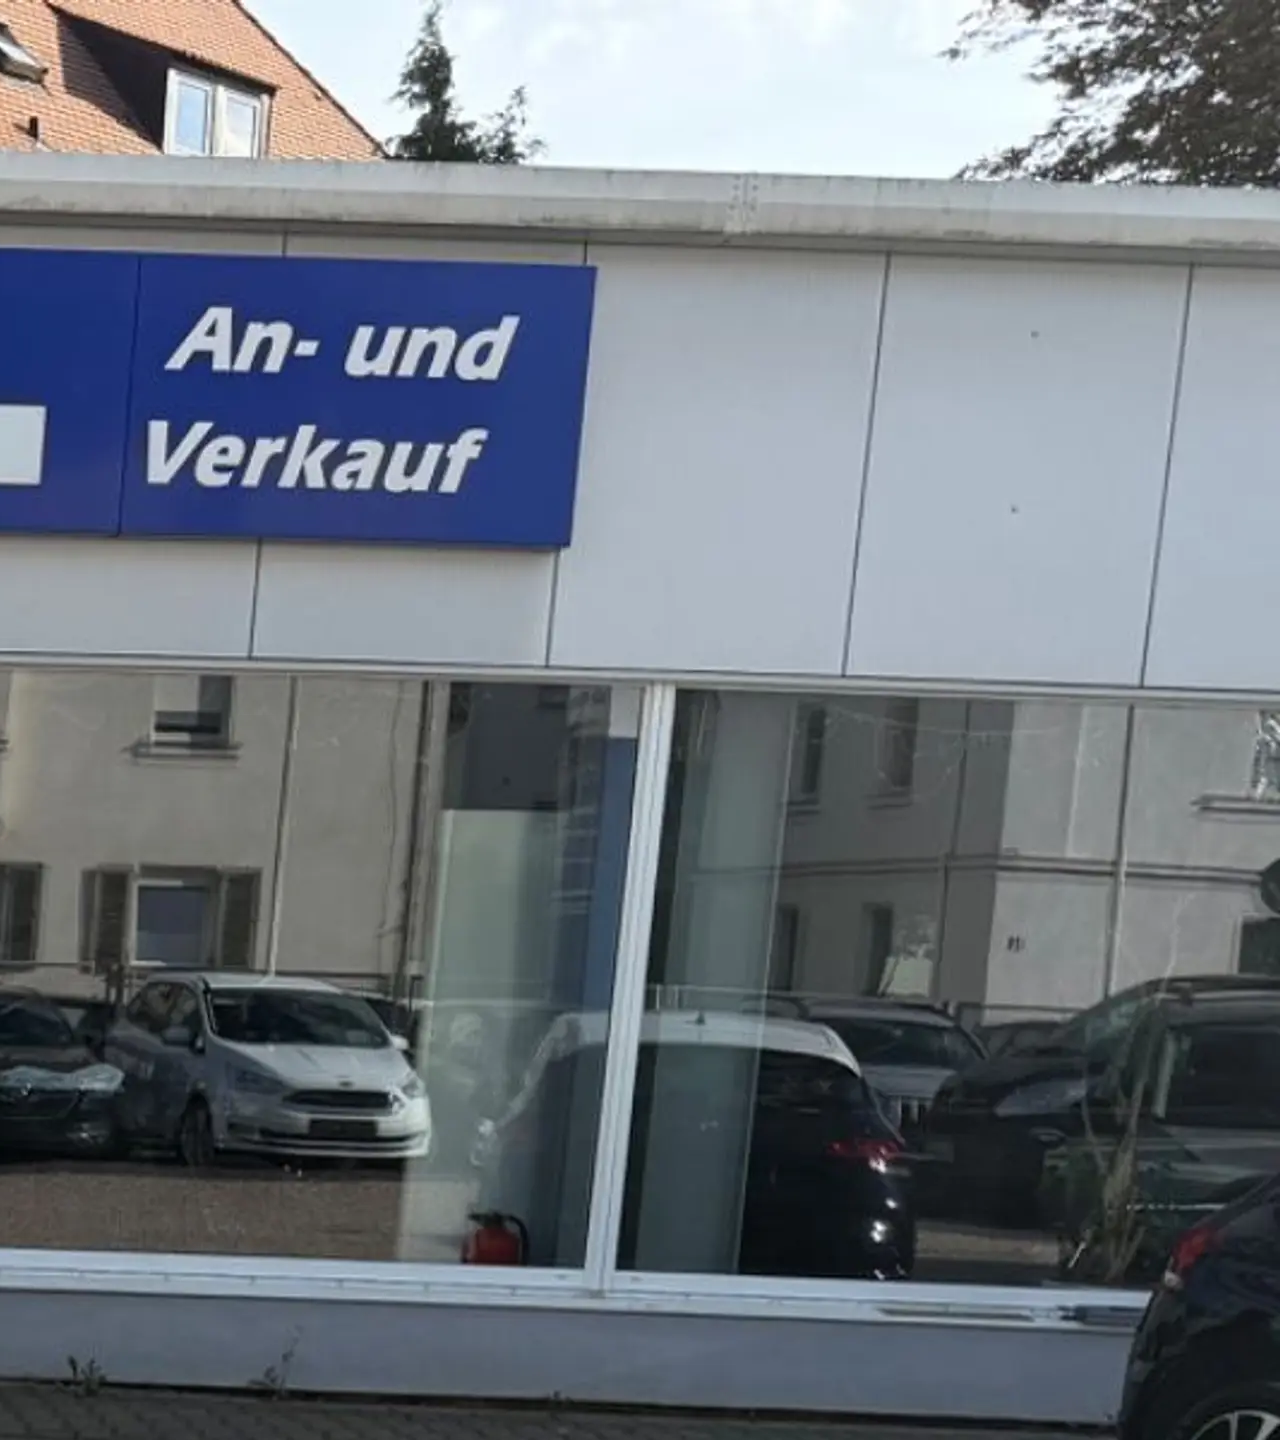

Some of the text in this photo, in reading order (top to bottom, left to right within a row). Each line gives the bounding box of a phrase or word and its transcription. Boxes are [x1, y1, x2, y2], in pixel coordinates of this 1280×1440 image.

[164, 306, 520, 381] An- und
[147, 419, 488, 493] Verkauf
